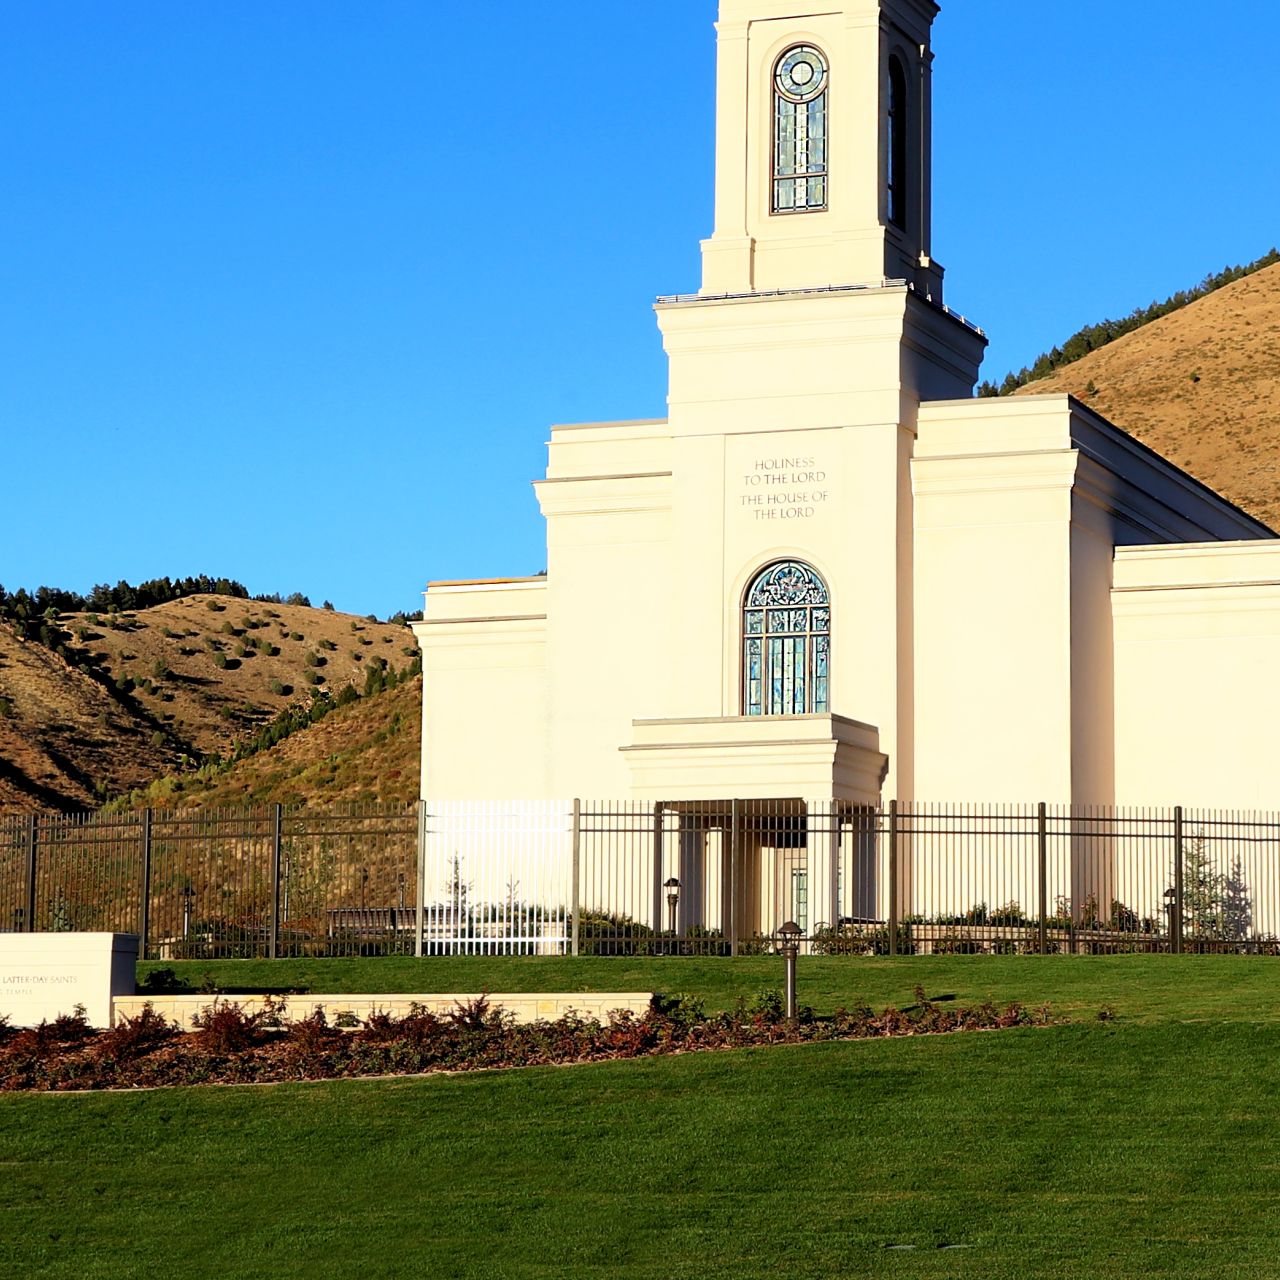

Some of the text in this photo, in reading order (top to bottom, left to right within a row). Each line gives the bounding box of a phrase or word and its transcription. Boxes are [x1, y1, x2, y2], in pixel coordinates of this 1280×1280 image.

[755, 456, 815, 470] HOLINESS
[744, 471, 826, 486] TO THE LORD
[739, 490, 828, 505] THE HOUSE OF
[753, 507, 814, 520] THE LORD
[2, 976, 48, 984] LATTER-DAY
[49, 975, 78, 984] SAINTS
[5, 988, 33, 996] TEMPLE
